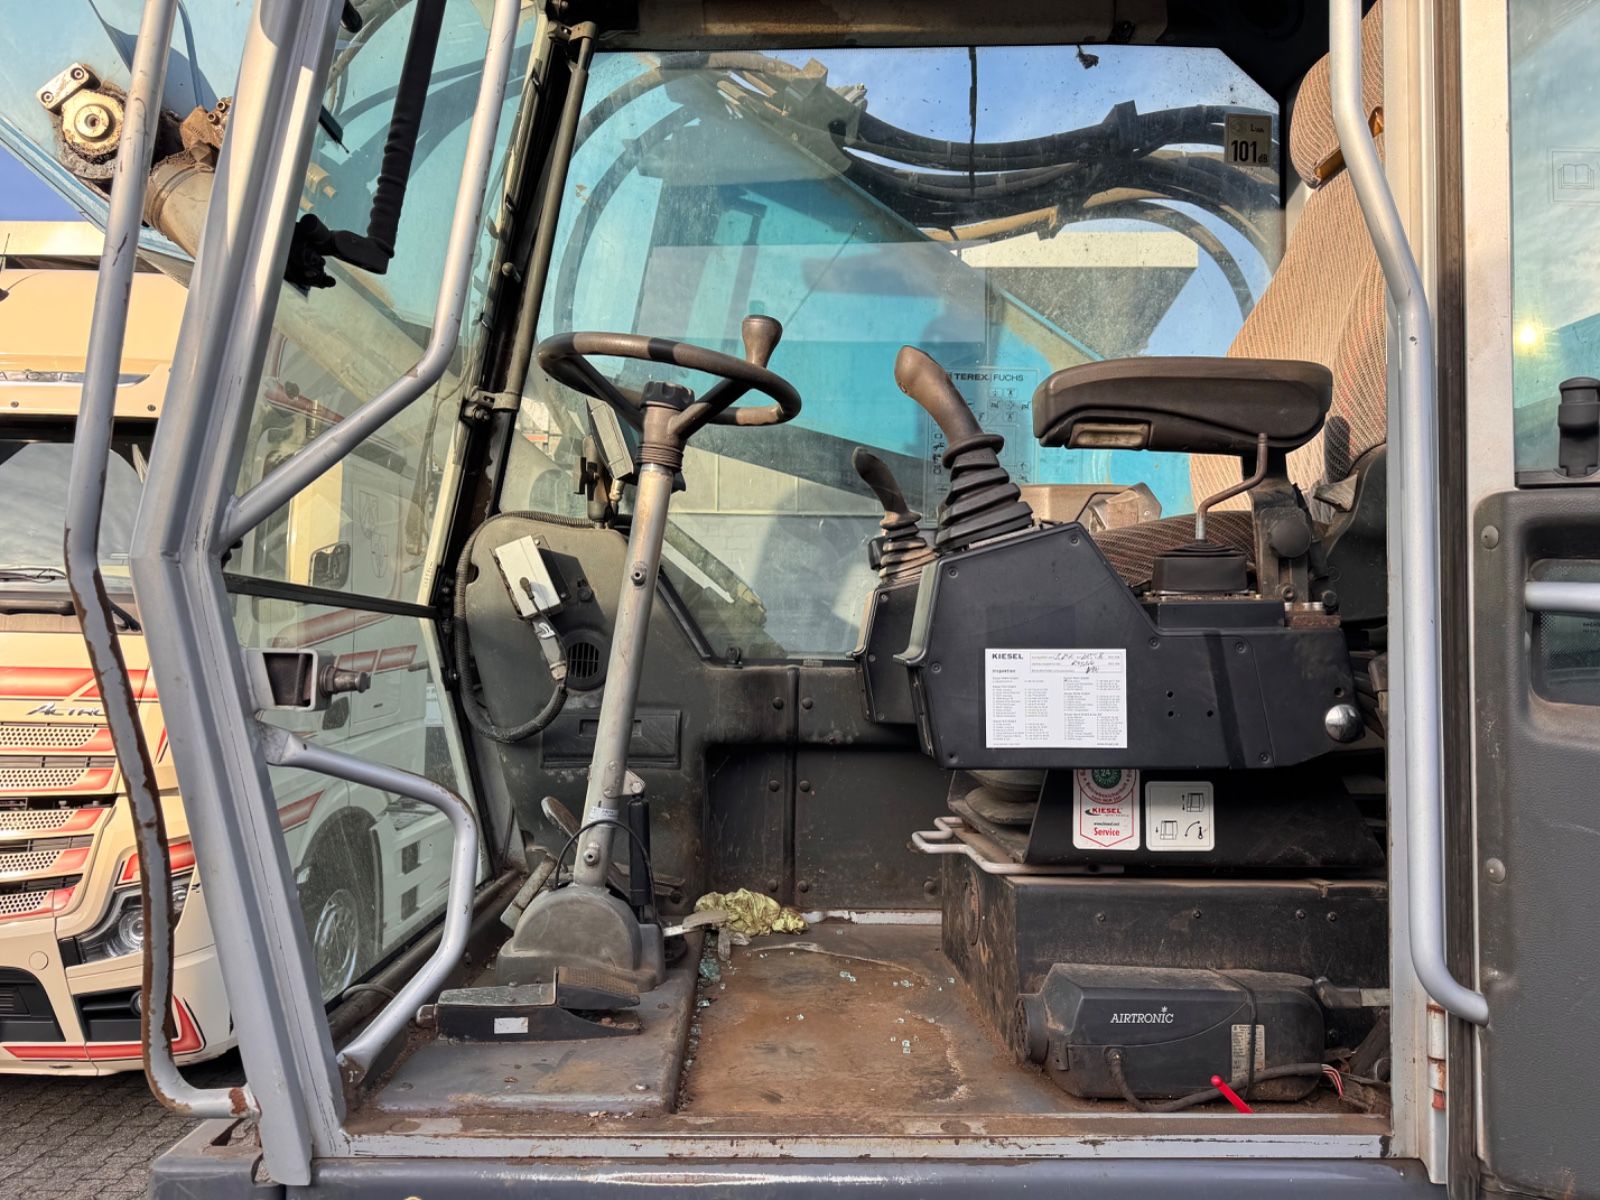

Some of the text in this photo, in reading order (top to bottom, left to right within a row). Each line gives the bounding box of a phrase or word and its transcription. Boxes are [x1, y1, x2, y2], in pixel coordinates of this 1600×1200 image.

[1231, 140, 1257, 163] 101
[955, 373, 1024, 381] TEREX FUCHS
[1094, 827, 1120, 836] Service
[1110, 1013, 1174, 1024] AIRTRONIC
